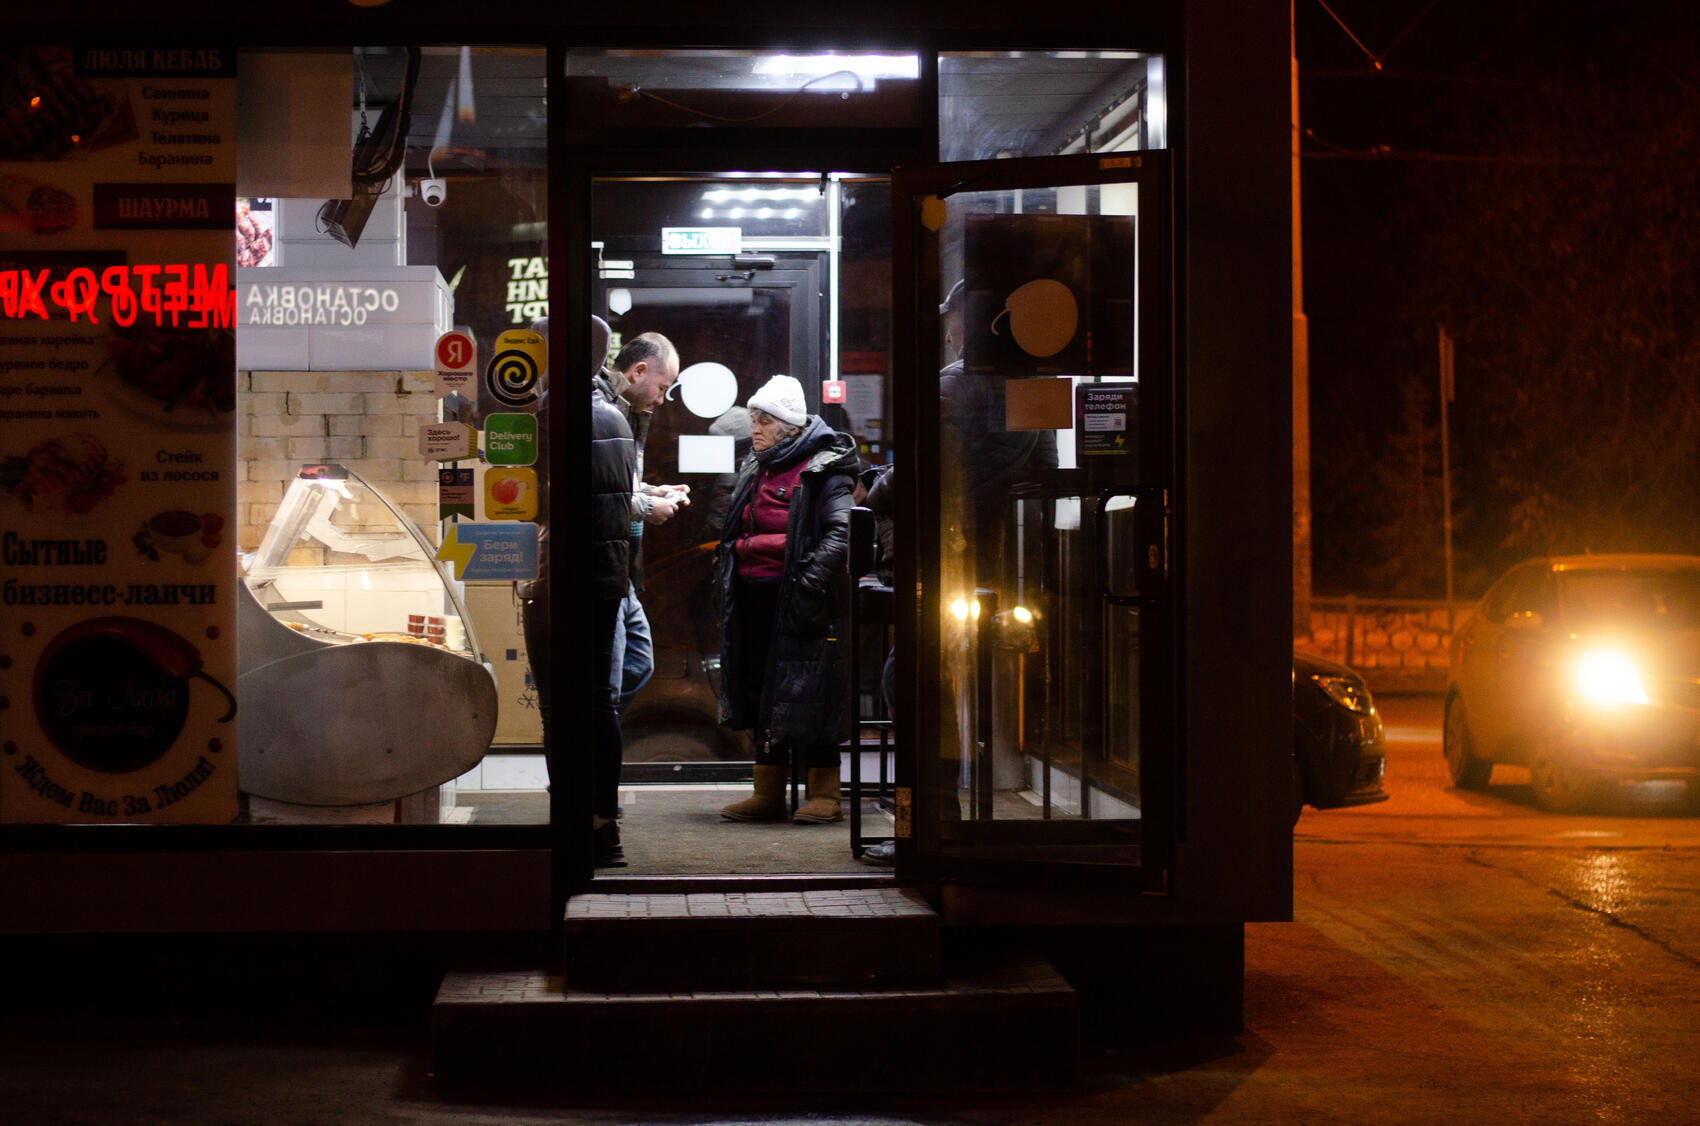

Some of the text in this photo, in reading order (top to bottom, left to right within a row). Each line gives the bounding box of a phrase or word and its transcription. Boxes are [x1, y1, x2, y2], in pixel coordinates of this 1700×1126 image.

[84, 49, 222, 69] ЛЮЛЯ КЕБАБ
[142, 86, 210, 99] Свинина
[152, 108, 210, 126] Курица
[151, 131, 221, 145] Телятина
[138, 152, 213, 169] Баранина
[119, 198, 209, 218] ШАУРМА
[667, 231, 738, 249] ВЫХ
[447, 341, 462, 363] Я
[48, 358, 89, 374] бедро
[1087, 393, 1123, 401] Заряди
[1084, 402, 1126, 412] телефон
[489, 431, 532, 441] Delivery
[489, 441, 514, 450] Club
[156, 450, 203, 463] Стейк
[140, 470, 218, 482] из лосося
[3, 531, 107, 566] Сытные
[484, 539, 518, 551] Бери
[480, 551, 523, 563] заряд!
[3, 579, 216, 605] бизнесс-ланчи
[77, 791, 119, 817] Вас
[122, 794, 153, 816] За
